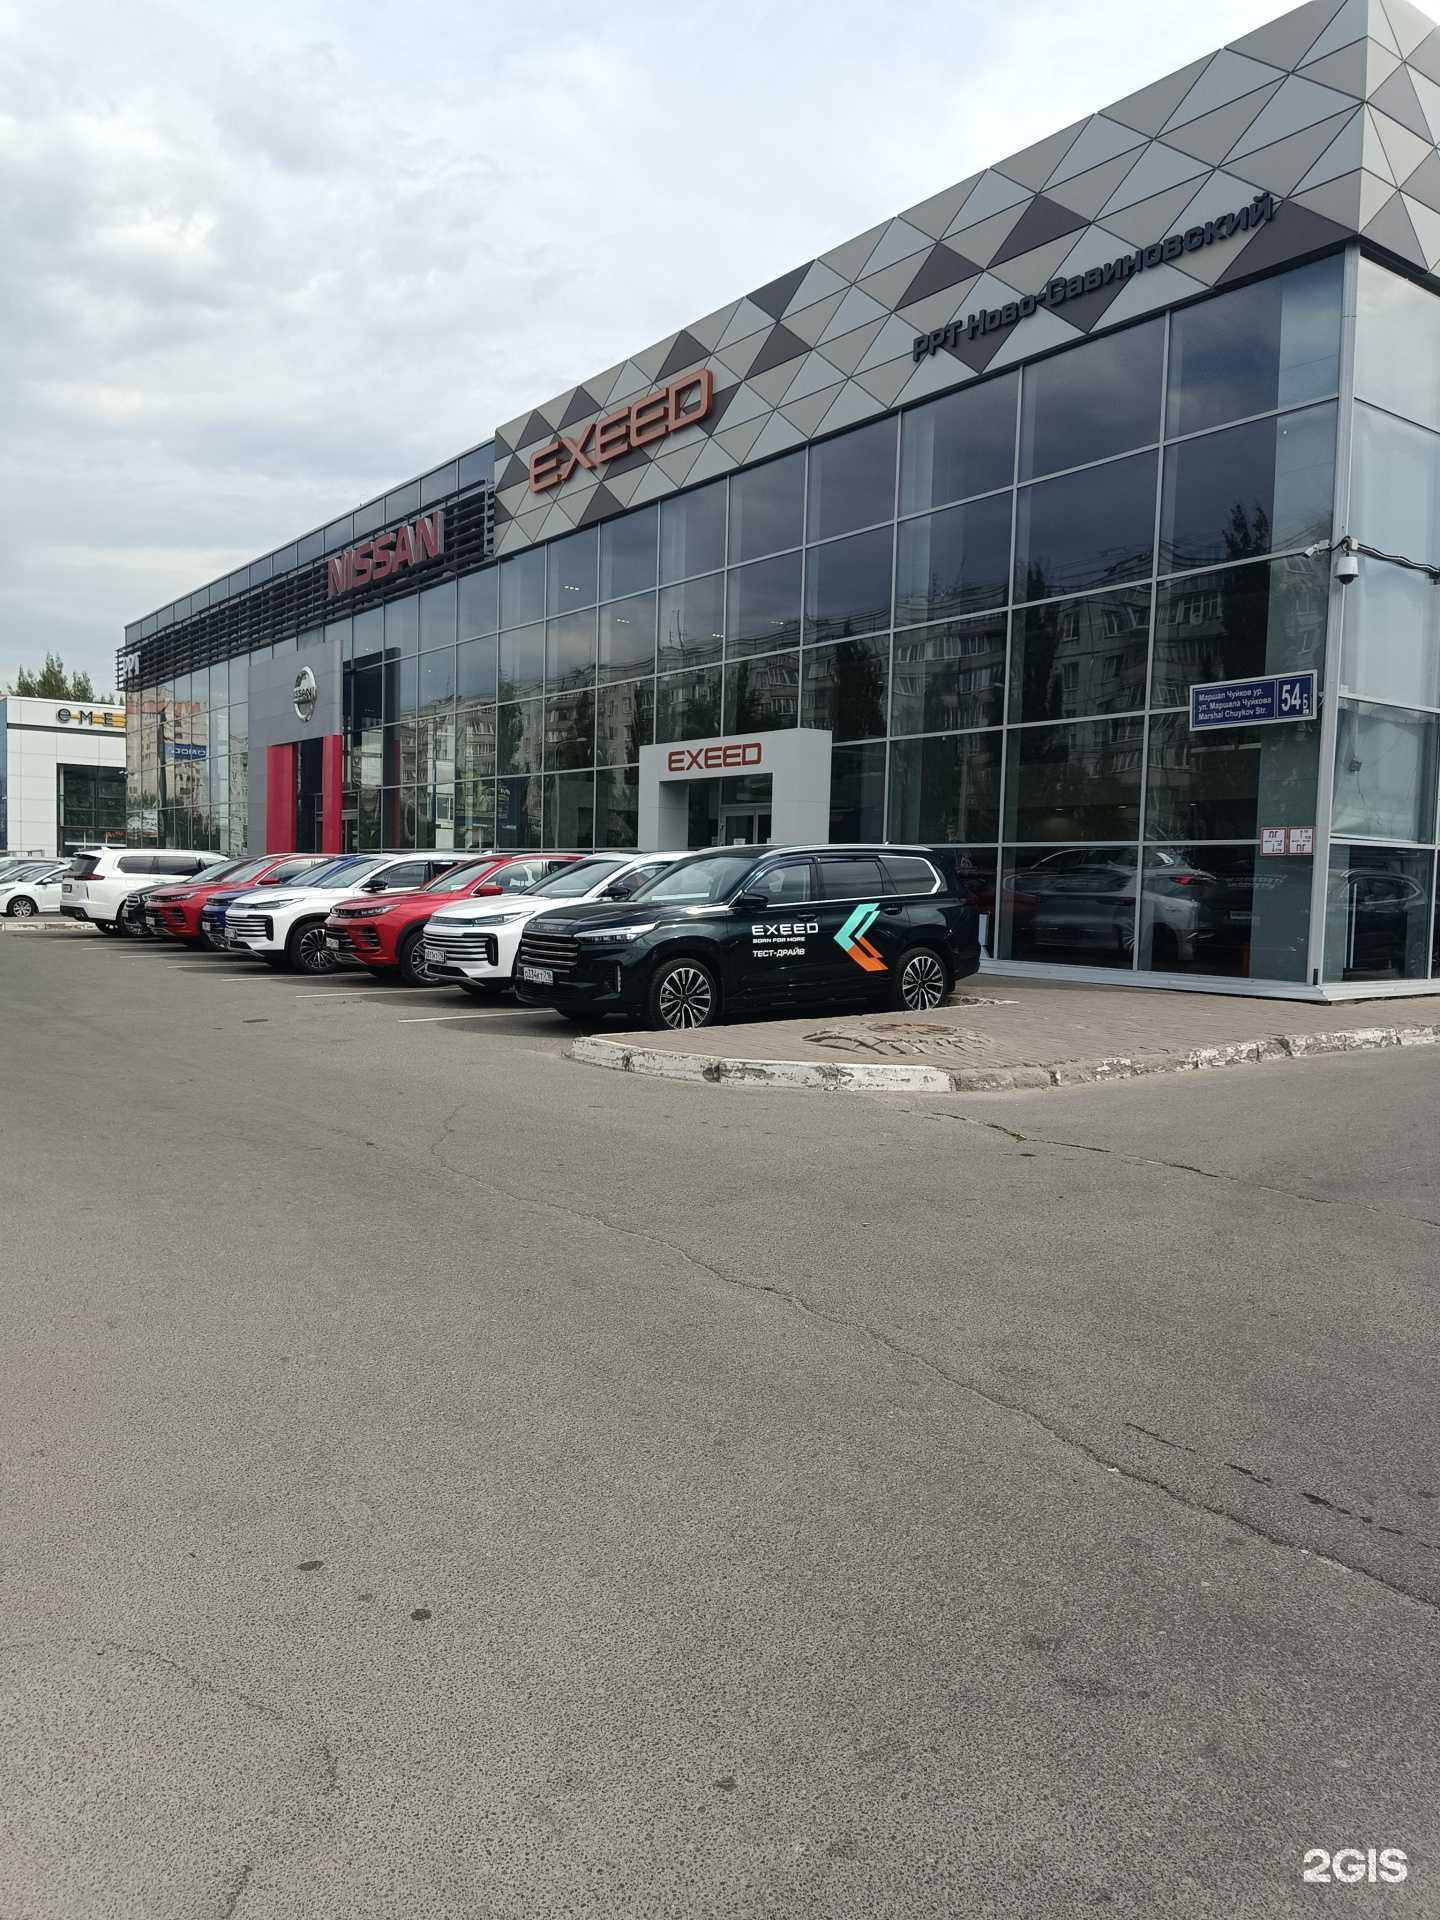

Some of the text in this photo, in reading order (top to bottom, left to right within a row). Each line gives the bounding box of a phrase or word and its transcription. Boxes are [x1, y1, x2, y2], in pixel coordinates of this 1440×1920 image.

[966, 191, 1275, 342] Ново-Савиновский
[528, 367, 713, 494] EXEED
[326, 510, 445, 599] NISSAN
[1198, 693, 1225, 702] Маршал
[1226, 689, 1252, 700] Чуйков
[1209, 700, 1241, 710] Маршала
[1242, 697, 1272, 707] Чуйкова
[1198, 711, 1224, 721] Marshal
[1224, 709, 1254, 719] Chuykov
[667, 742, 762, 772] EXEED
[751, 922, 819, 936] EXEED
[752, 946, 806, 958] ТЕСТ-ДРАЙВ
